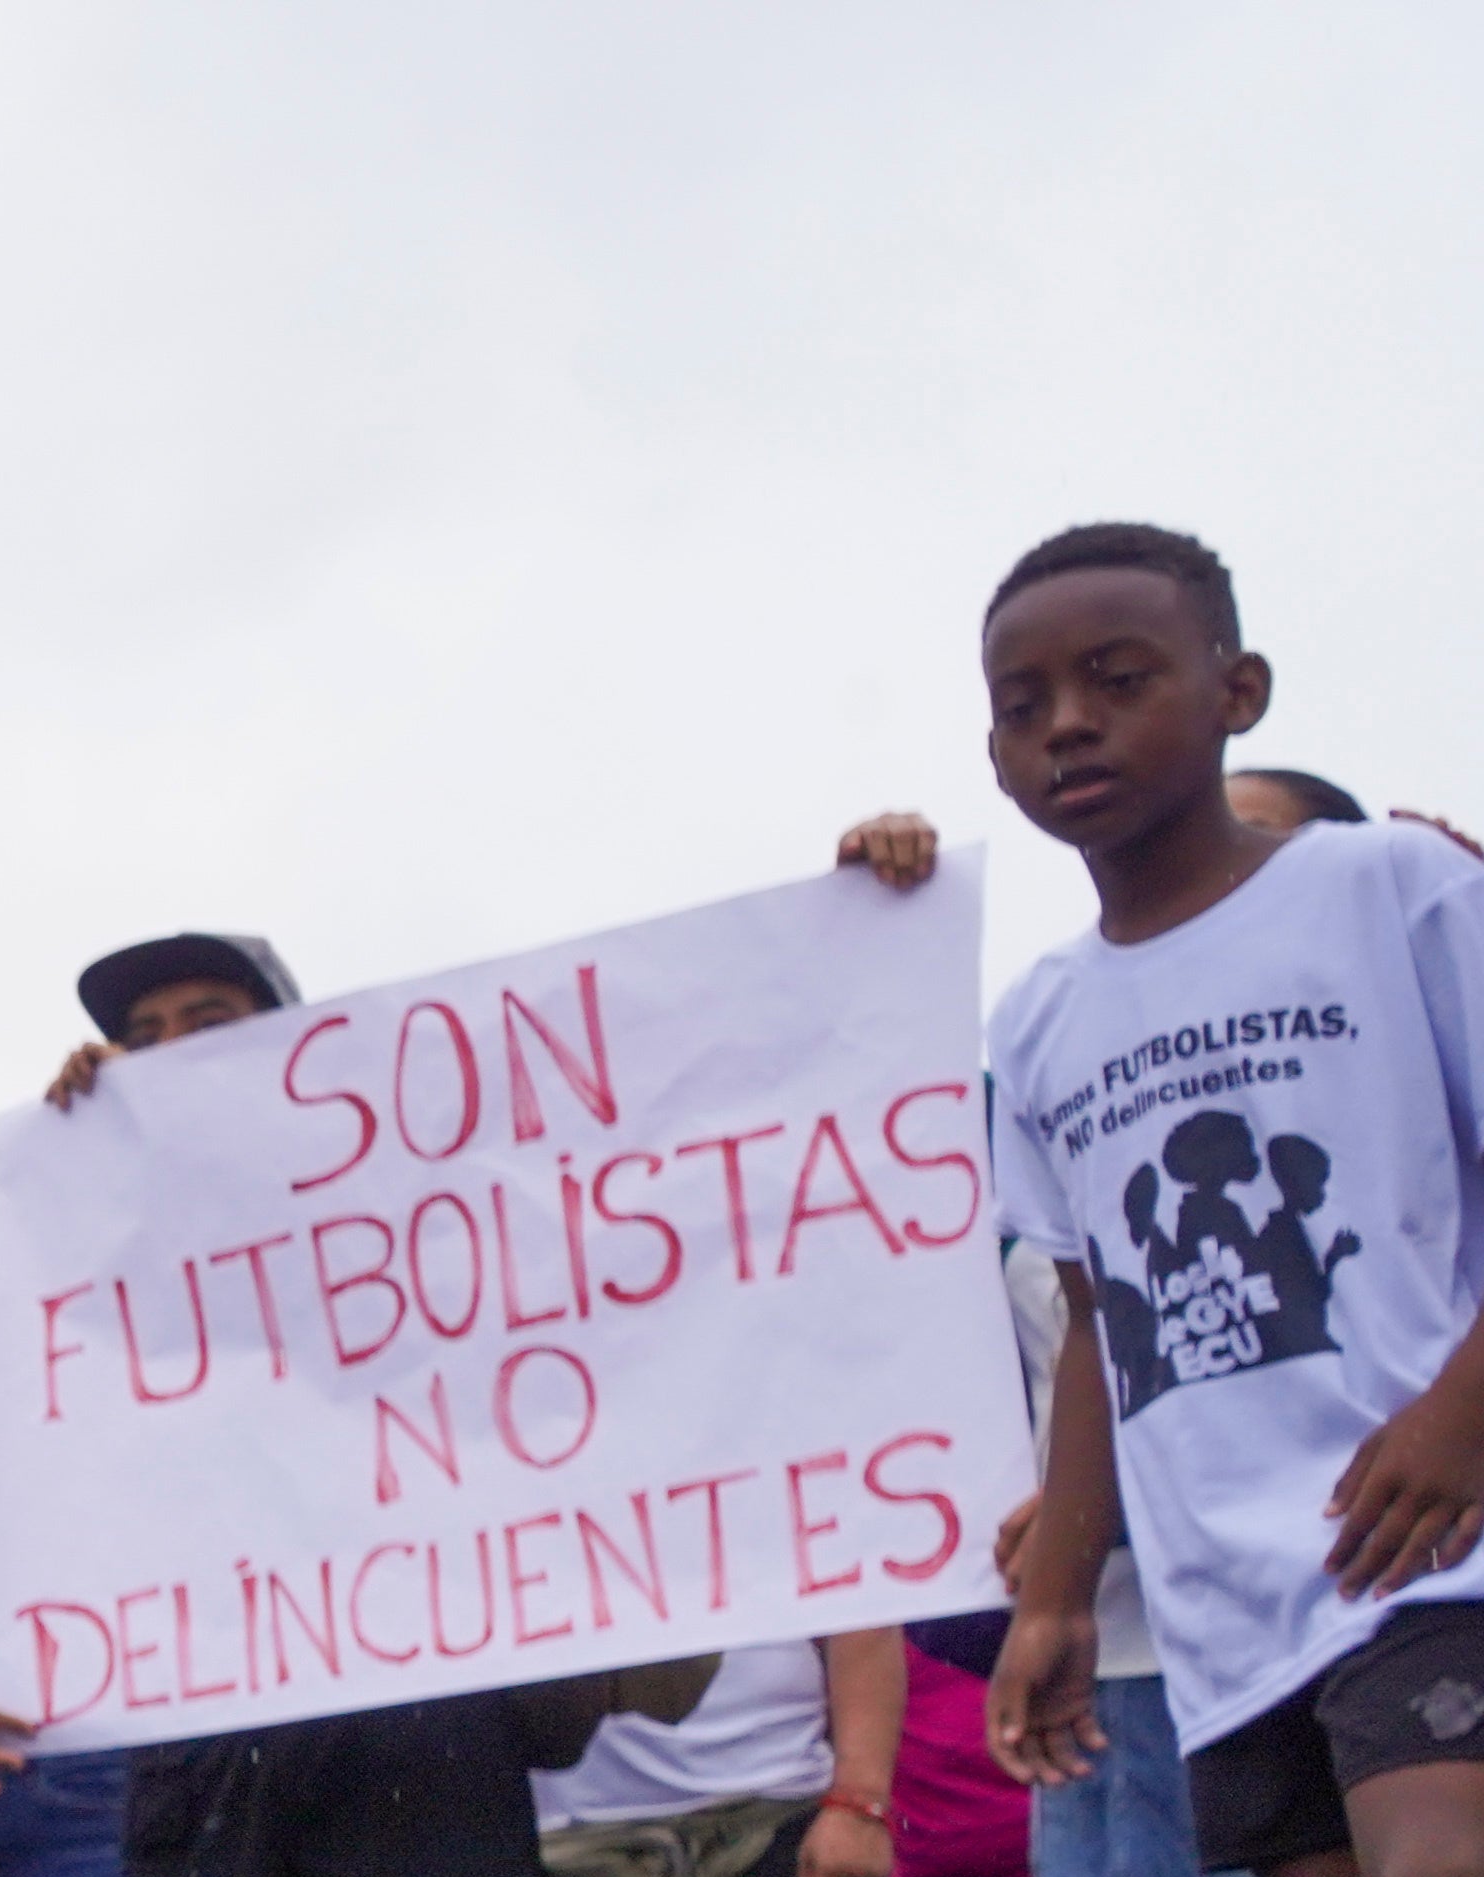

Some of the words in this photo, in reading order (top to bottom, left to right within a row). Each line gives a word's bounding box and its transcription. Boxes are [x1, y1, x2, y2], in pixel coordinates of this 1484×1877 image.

[282, 962, 620, 1194] SON
[1103, 1003, 1360, 1095] FUTBOLISTAS,
[1064, 1114, 1096, 1160] NO
[38, 1079, 982, 1422] FUTBOLISTAS
[372, 1343, 600, 1506] NO
